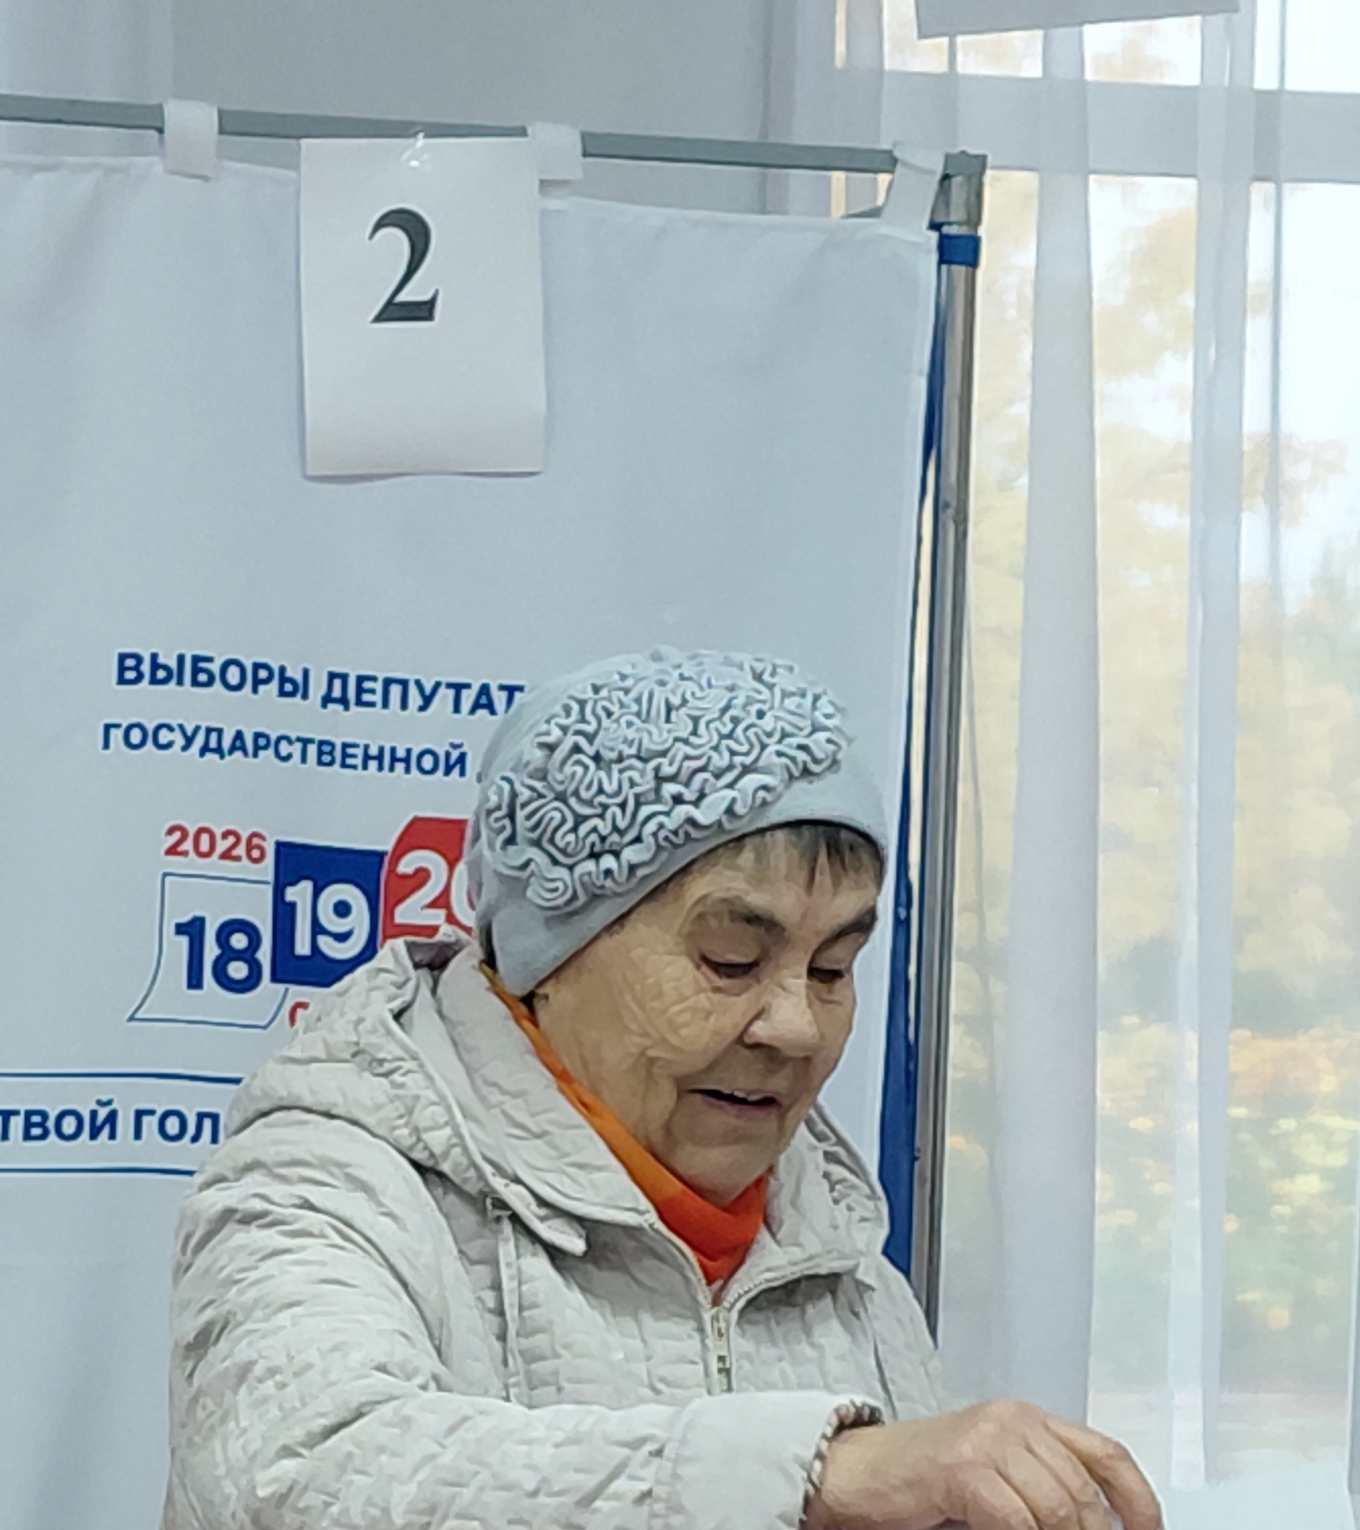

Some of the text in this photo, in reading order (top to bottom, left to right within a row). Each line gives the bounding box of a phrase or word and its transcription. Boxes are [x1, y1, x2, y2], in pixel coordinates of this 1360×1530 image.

[368, 207, 440, 323] 2
[115, 651, 526, 717] ВЫБОРЫ ДЕПУТАТ
[101, 721, 469, 779] ГОСУДАРСТВЕННОЙ
[164, 824, 267, 864] 2026
[173, 914, 264, 995] 18
[284, 879, 371, 960] 19
[132, 1107, 221, 1146] ГОЛ
